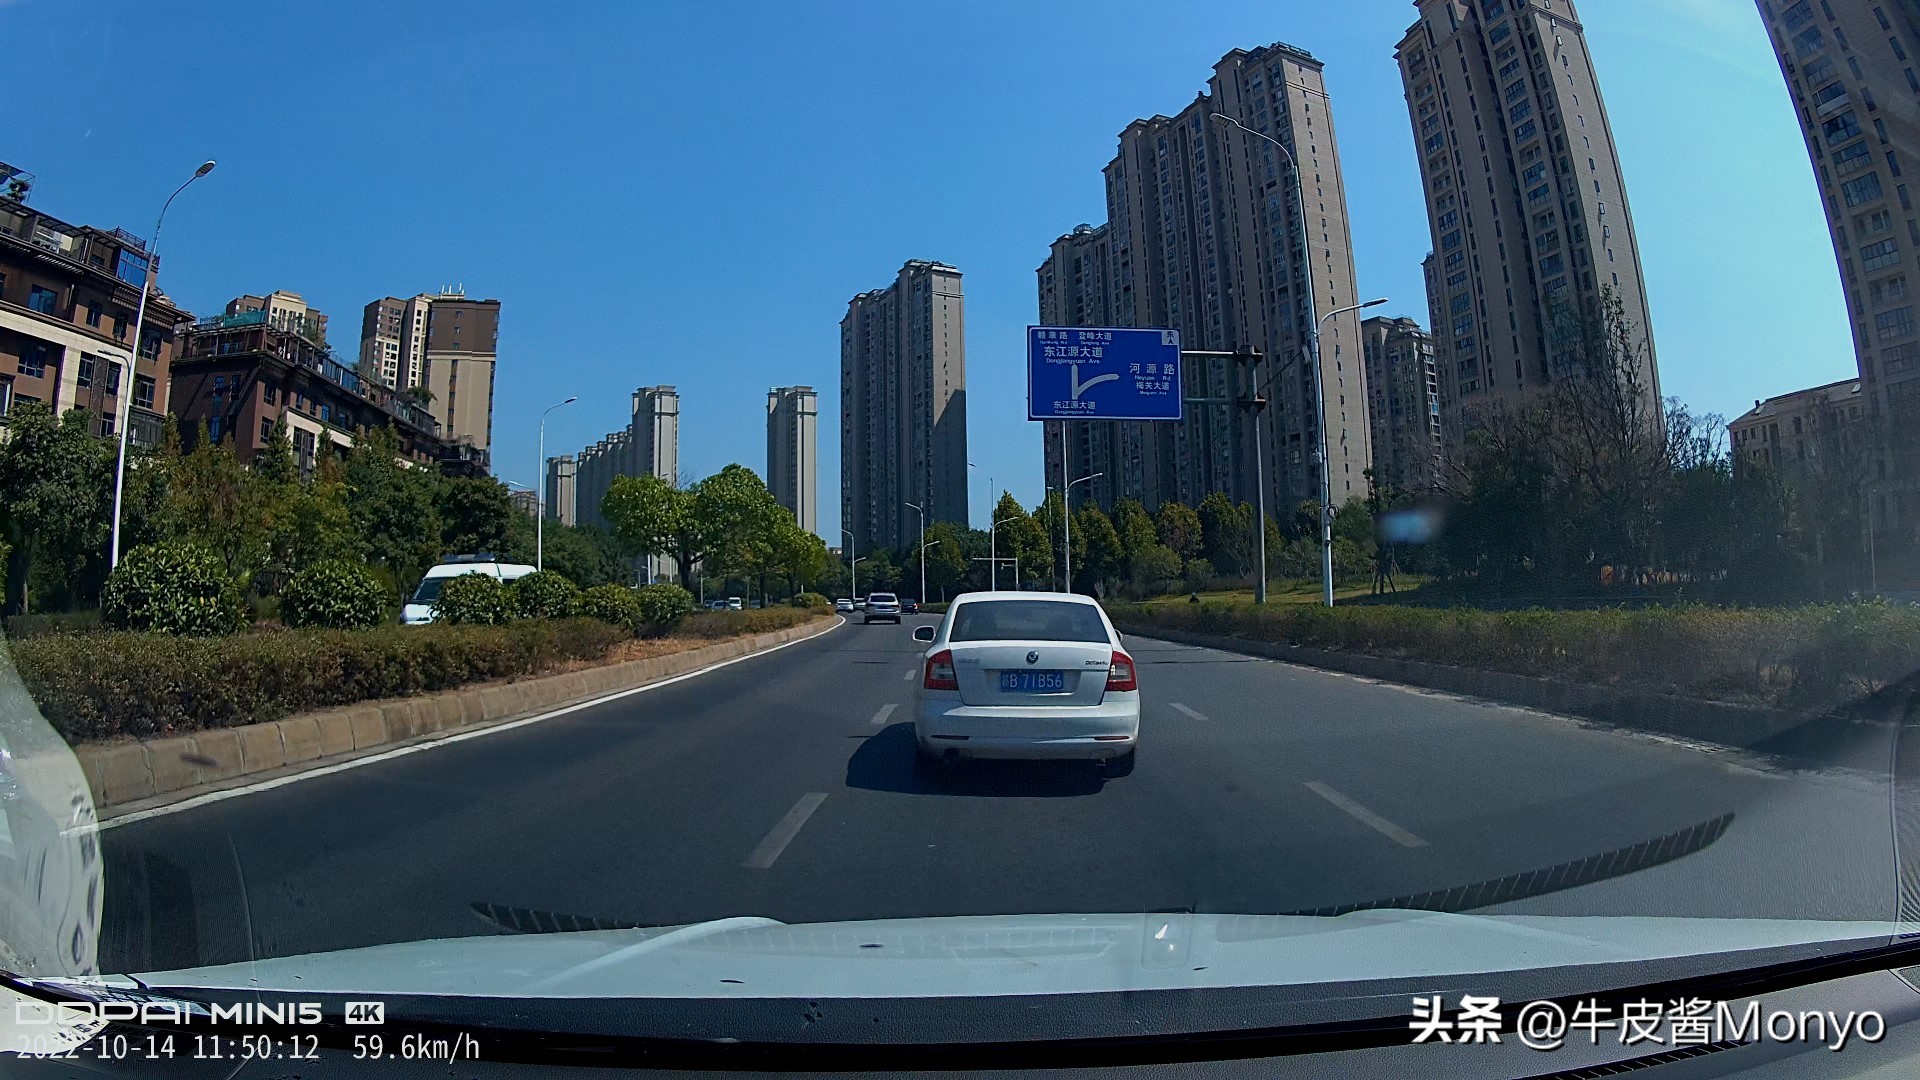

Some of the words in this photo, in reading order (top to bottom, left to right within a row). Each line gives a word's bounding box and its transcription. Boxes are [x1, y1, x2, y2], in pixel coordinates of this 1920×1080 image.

[1166, 331, 1175, 339] 东
[1043, 346, 1104, 358] 东江源大道
[1046, 357, 1086, 365] Dongjiangyuan
[1129, 362, 1175, 375] 河源路
[1136, 381, 1170, 391] 梅关大道
[1053, 400, 1096, 410] 东江源大道
